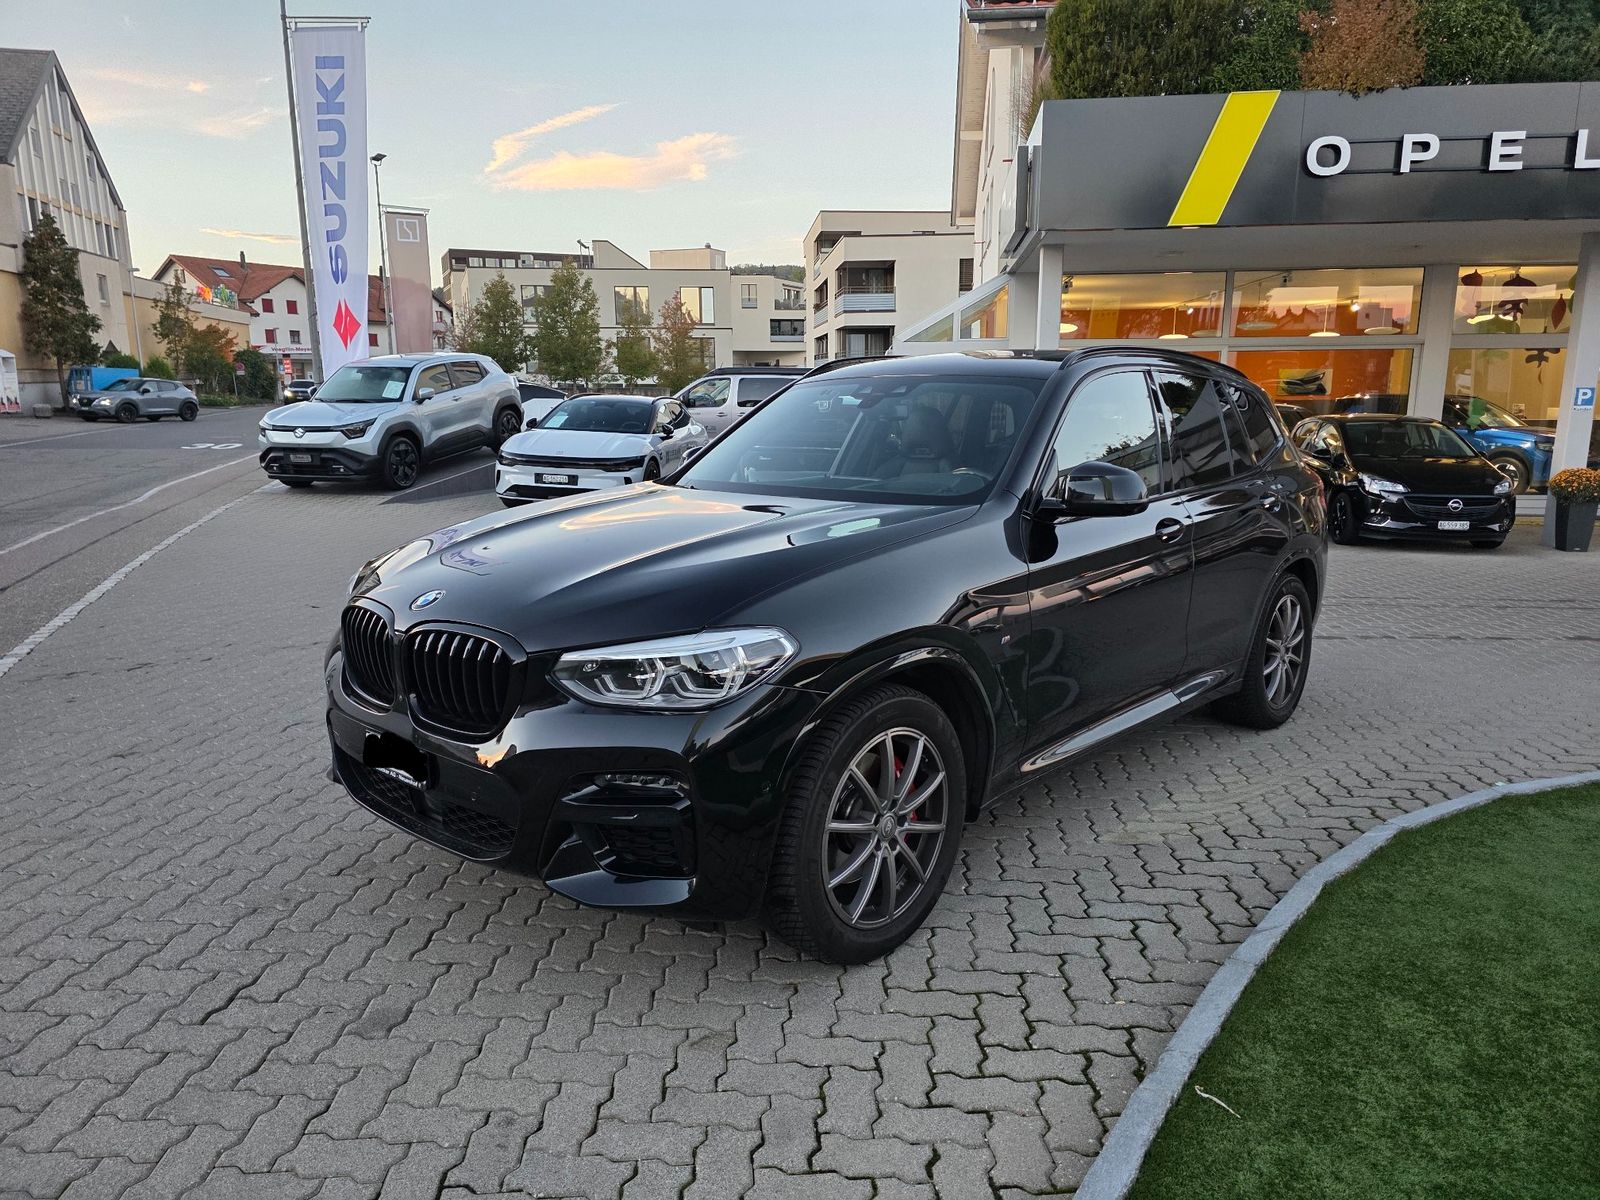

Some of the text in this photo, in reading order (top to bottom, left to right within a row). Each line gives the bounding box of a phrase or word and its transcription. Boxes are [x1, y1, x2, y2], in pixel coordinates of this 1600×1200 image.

[315, 56, 347, 284] SUZUKI
[1306, 129, 1600, 176] OPEL
[1577, 388, 1592, 405] P
